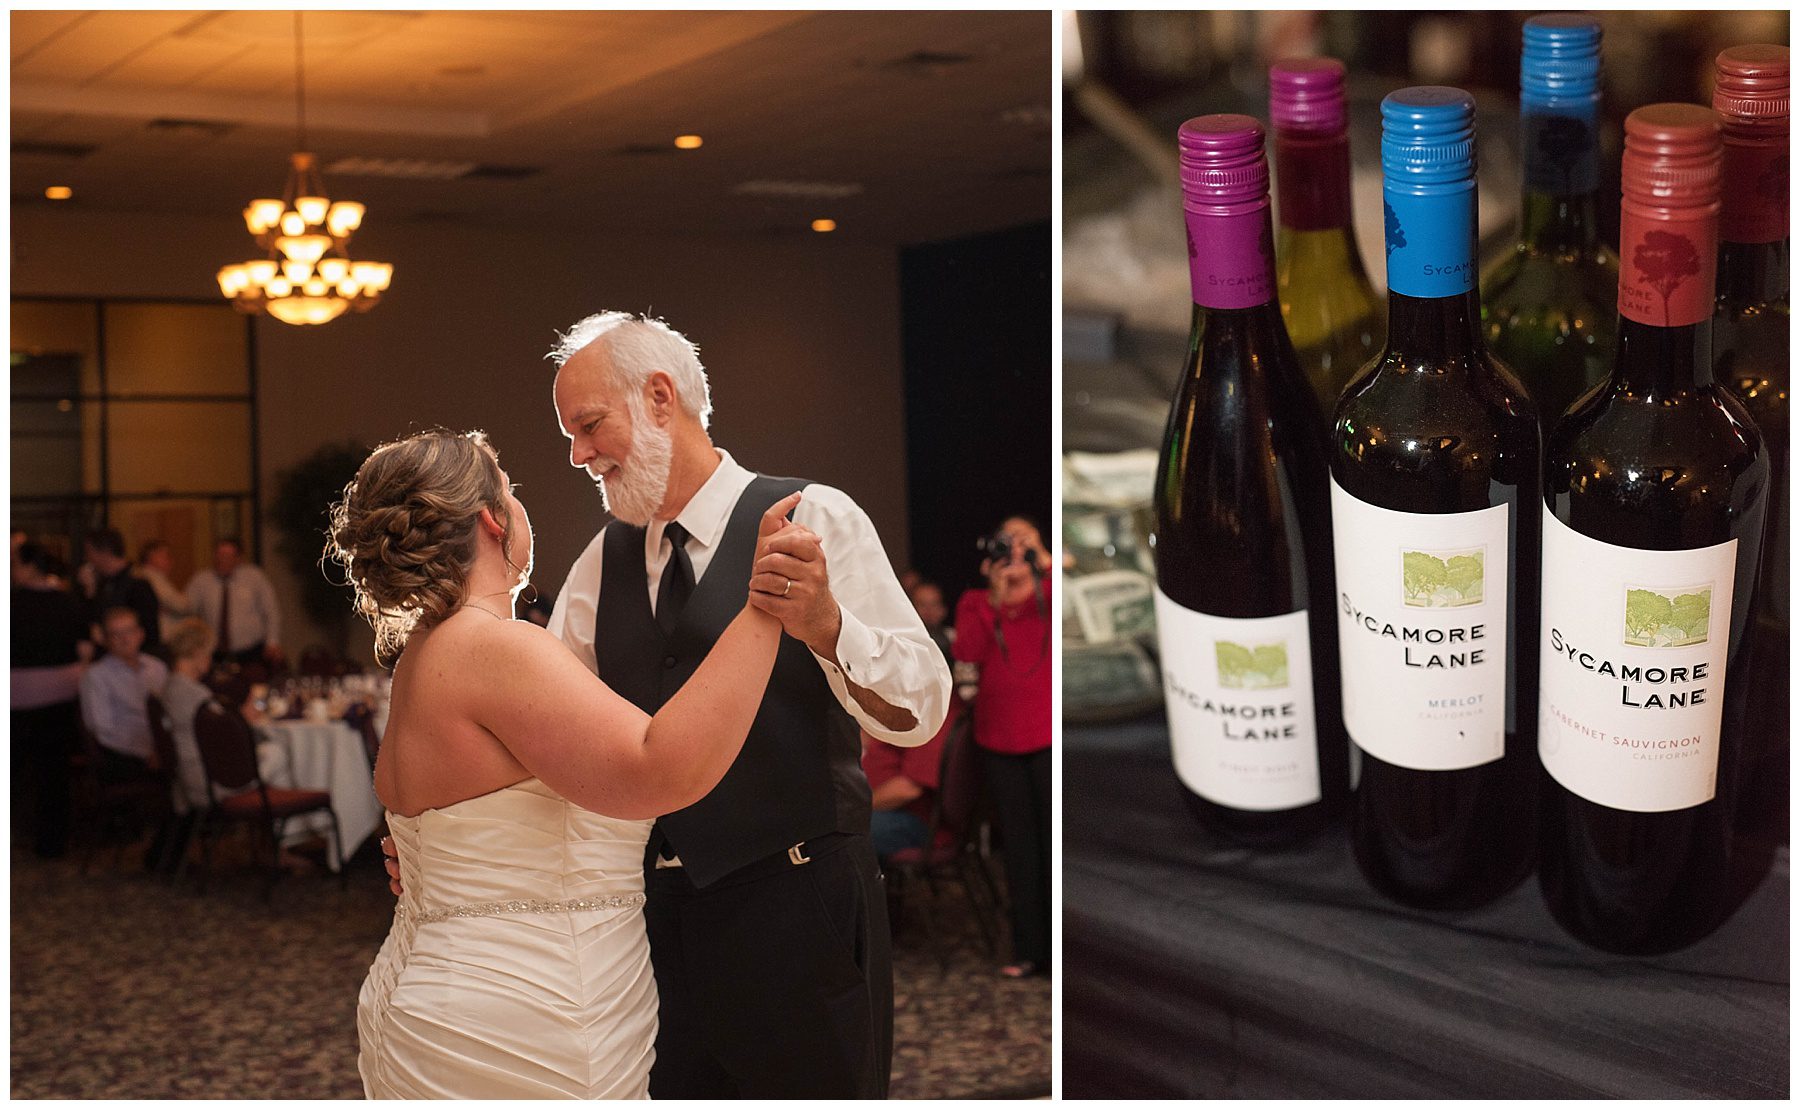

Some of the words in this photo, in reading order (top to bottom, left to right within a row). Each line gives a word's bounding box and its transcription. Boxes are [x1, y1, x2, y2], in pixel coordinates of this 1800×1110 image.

[1341, 592, 1486, 644] SYCAMORE
[1405, 647, 1486, 669] LANE
[1550, 628, 1709, 684] SYCAMORE
[1428, 694, 1485, 709] MERLOT
[1621, 685, 1707, 709] LANE
[1222, 720, 1299, 743] LANE
[1549, 704, 1607, 742] CABERNET
[1612, 735, 1702, 750] SAUVIGNON
[1632, 749, 1701, 761] CALIFORNIA
